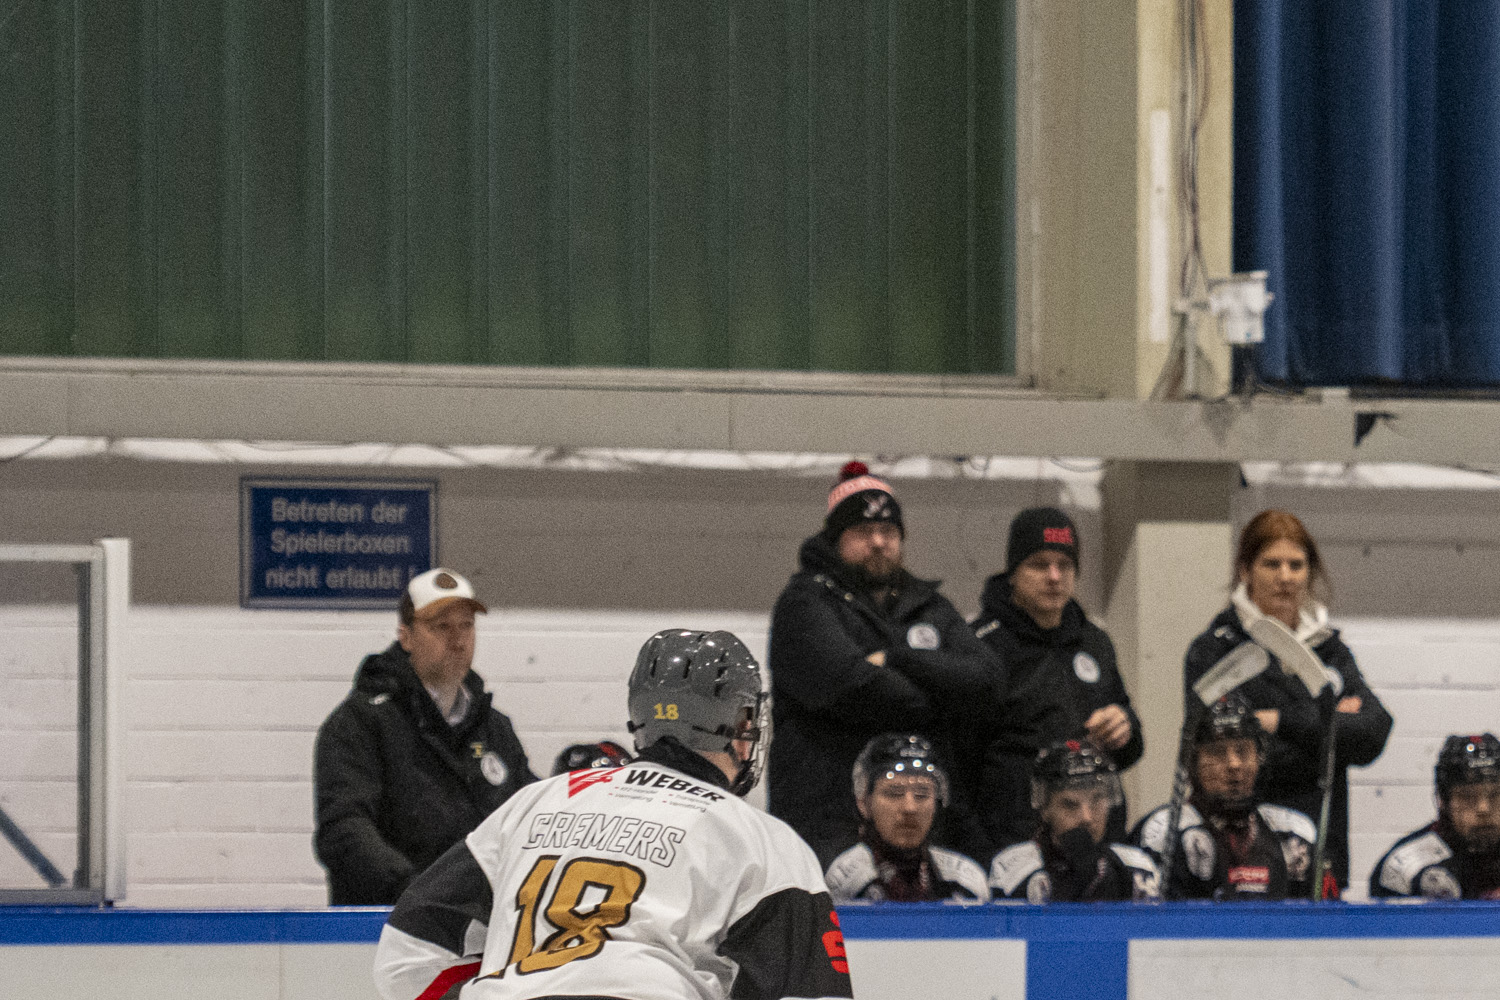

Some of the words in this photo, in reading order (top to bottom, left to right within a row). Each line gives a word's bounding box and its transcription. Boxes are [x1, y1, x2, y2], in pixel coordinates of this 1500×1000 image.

[271, 498, 365, 523] Betreten
[370, 499, 408, 524] der
[271, 527, 411, 556] Spielerboxen
[264, 567, 319, 589] nicht
[325, 567, 401, 590] erlaubt
[653, 703, 680, 721] 18
[624, 769, 727, 802] WEBER
[522, 811, 687, 868] CREMERS
[472, 854, 647, 985] 18
